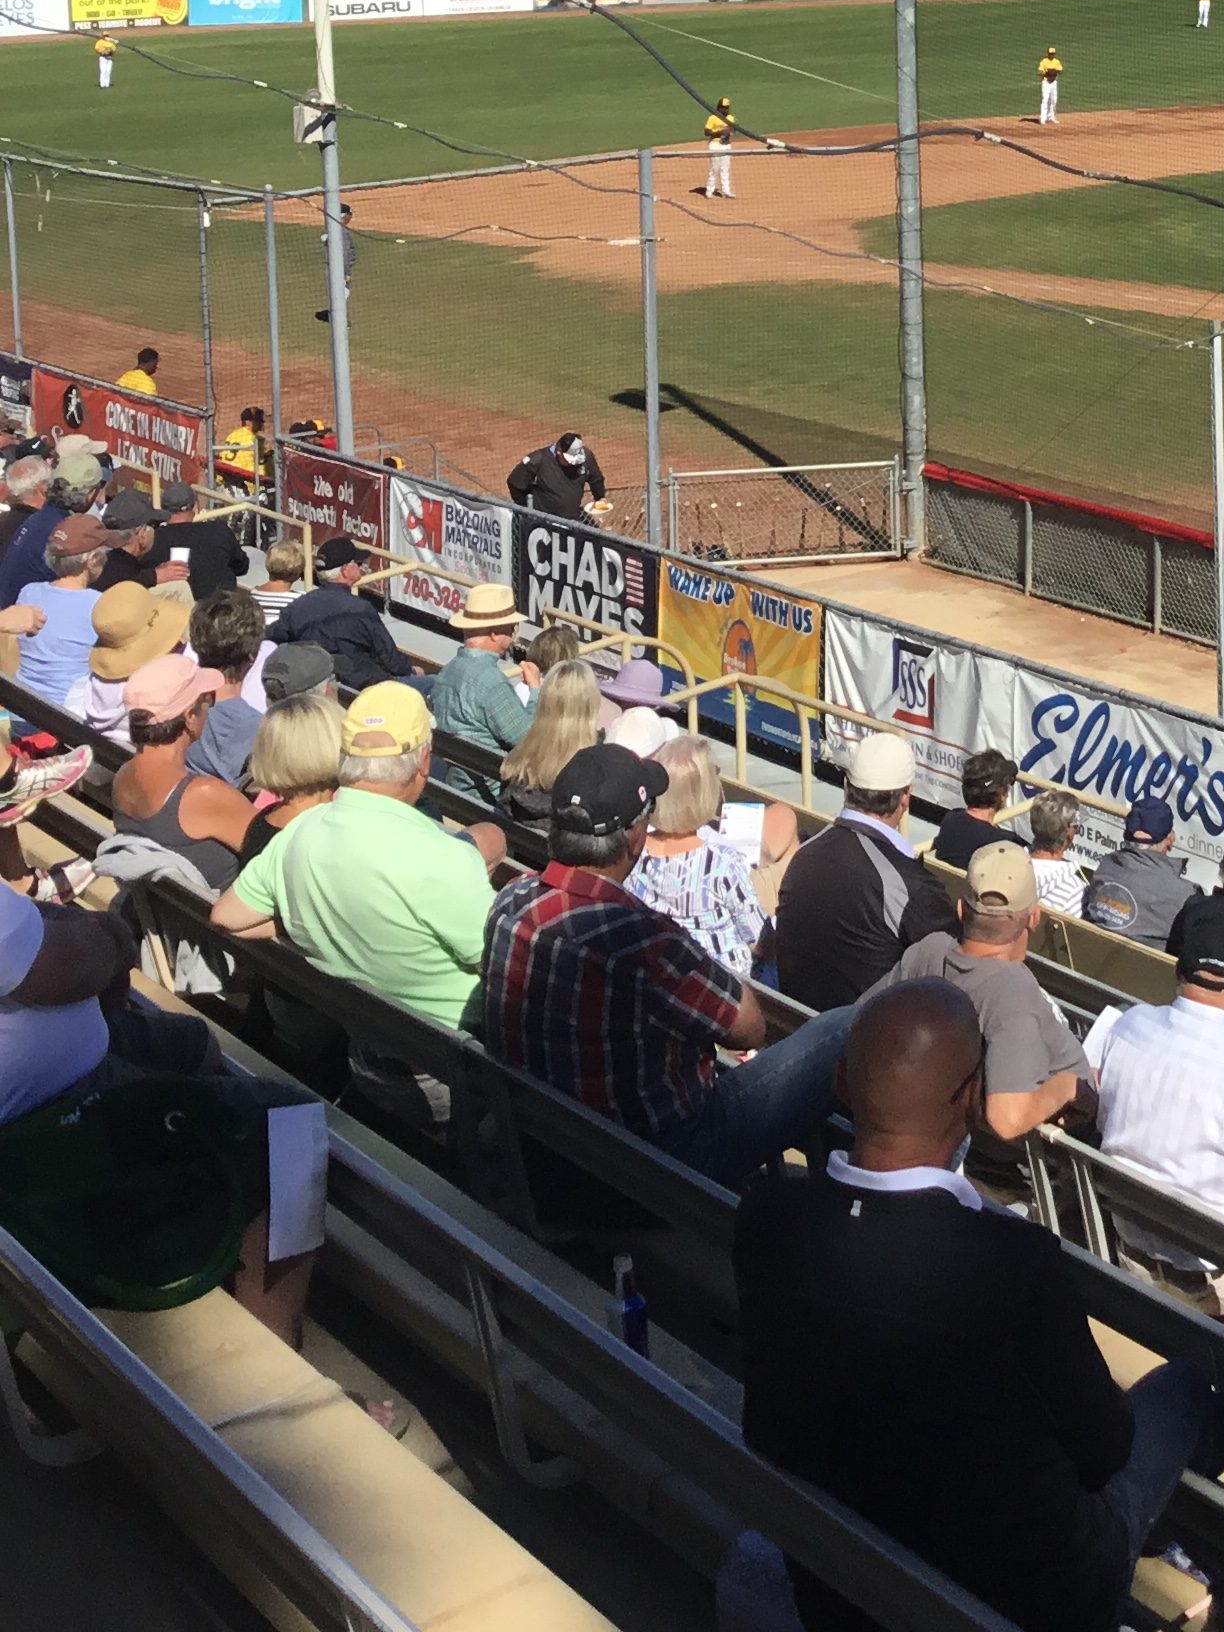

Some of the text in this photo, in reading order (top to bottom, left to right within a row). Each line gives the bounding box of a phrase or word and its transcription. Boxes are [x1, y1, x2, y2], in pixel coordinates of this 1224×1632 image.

[328, 1, 411, 16] SUBARU
[137, 408, 149, 440] IN
[313, 475, 354, 505] the old
[342, 509, 378, 545] factory
[446, 504, 501, 538] BUILDING
[445, 525, 502, 560] MATERIALS
[528, 527, 624, 598] CHAD
[529, 574, 645, 658] MAYES
[667, 565, 814, 635] WAKE UP WITH US
[1095, 830, 1117, 850] Palm
[1187, 834, 1223, 858] dinne
